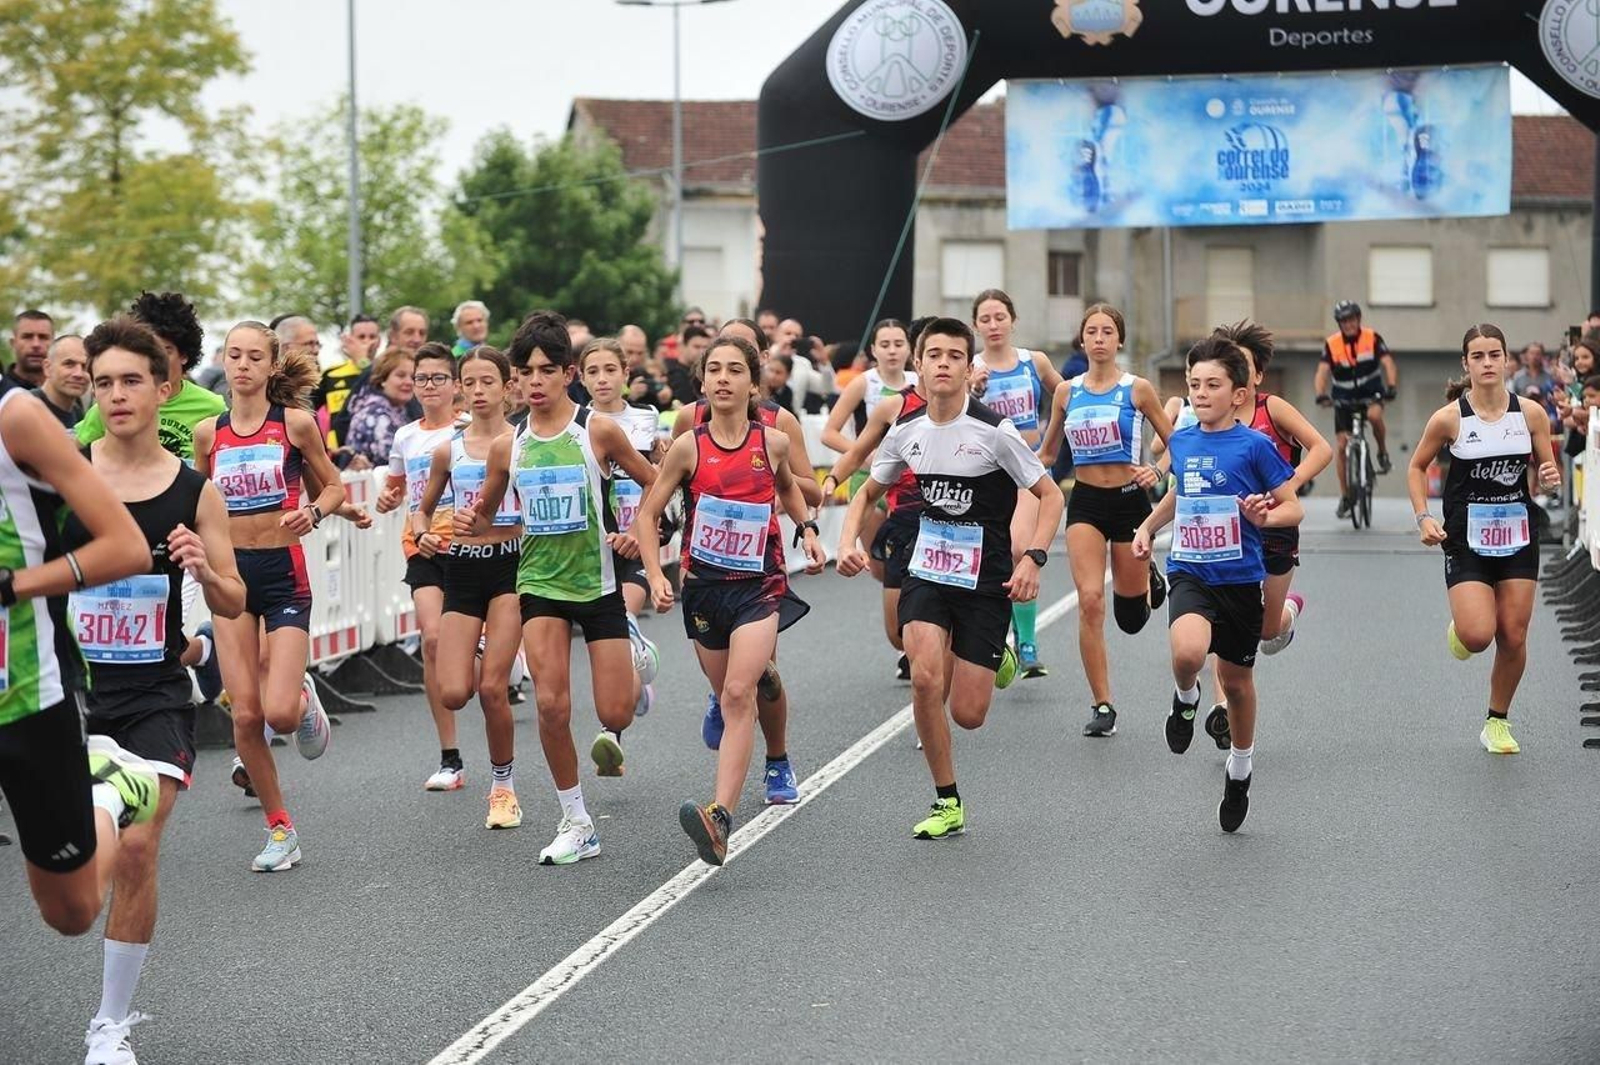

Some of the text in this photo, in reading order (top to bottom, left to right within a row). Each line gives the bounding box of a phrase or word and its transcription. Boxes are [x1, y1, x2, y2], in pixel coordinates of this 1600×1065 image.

[1269, 27, 1374, 49] Deportes
[1549, 5, 1577, 74] CONSELLO
[928, 25, 957, 93] DEPORTES
[1071, 427, 1110, 447] 3082
[220, 473, 272, 497] 3304
[1121, 483, 1139, 494] NIKE
[529, 496, 573, 521] 4007
[699, 524, 753, 557] 3202
[1179, 525, 1227, 549] 3088
[1480, 526, 1513, 547] 3011
[458, 544, 494, 559] PRO
[78, 612, 148, 646] 3042
